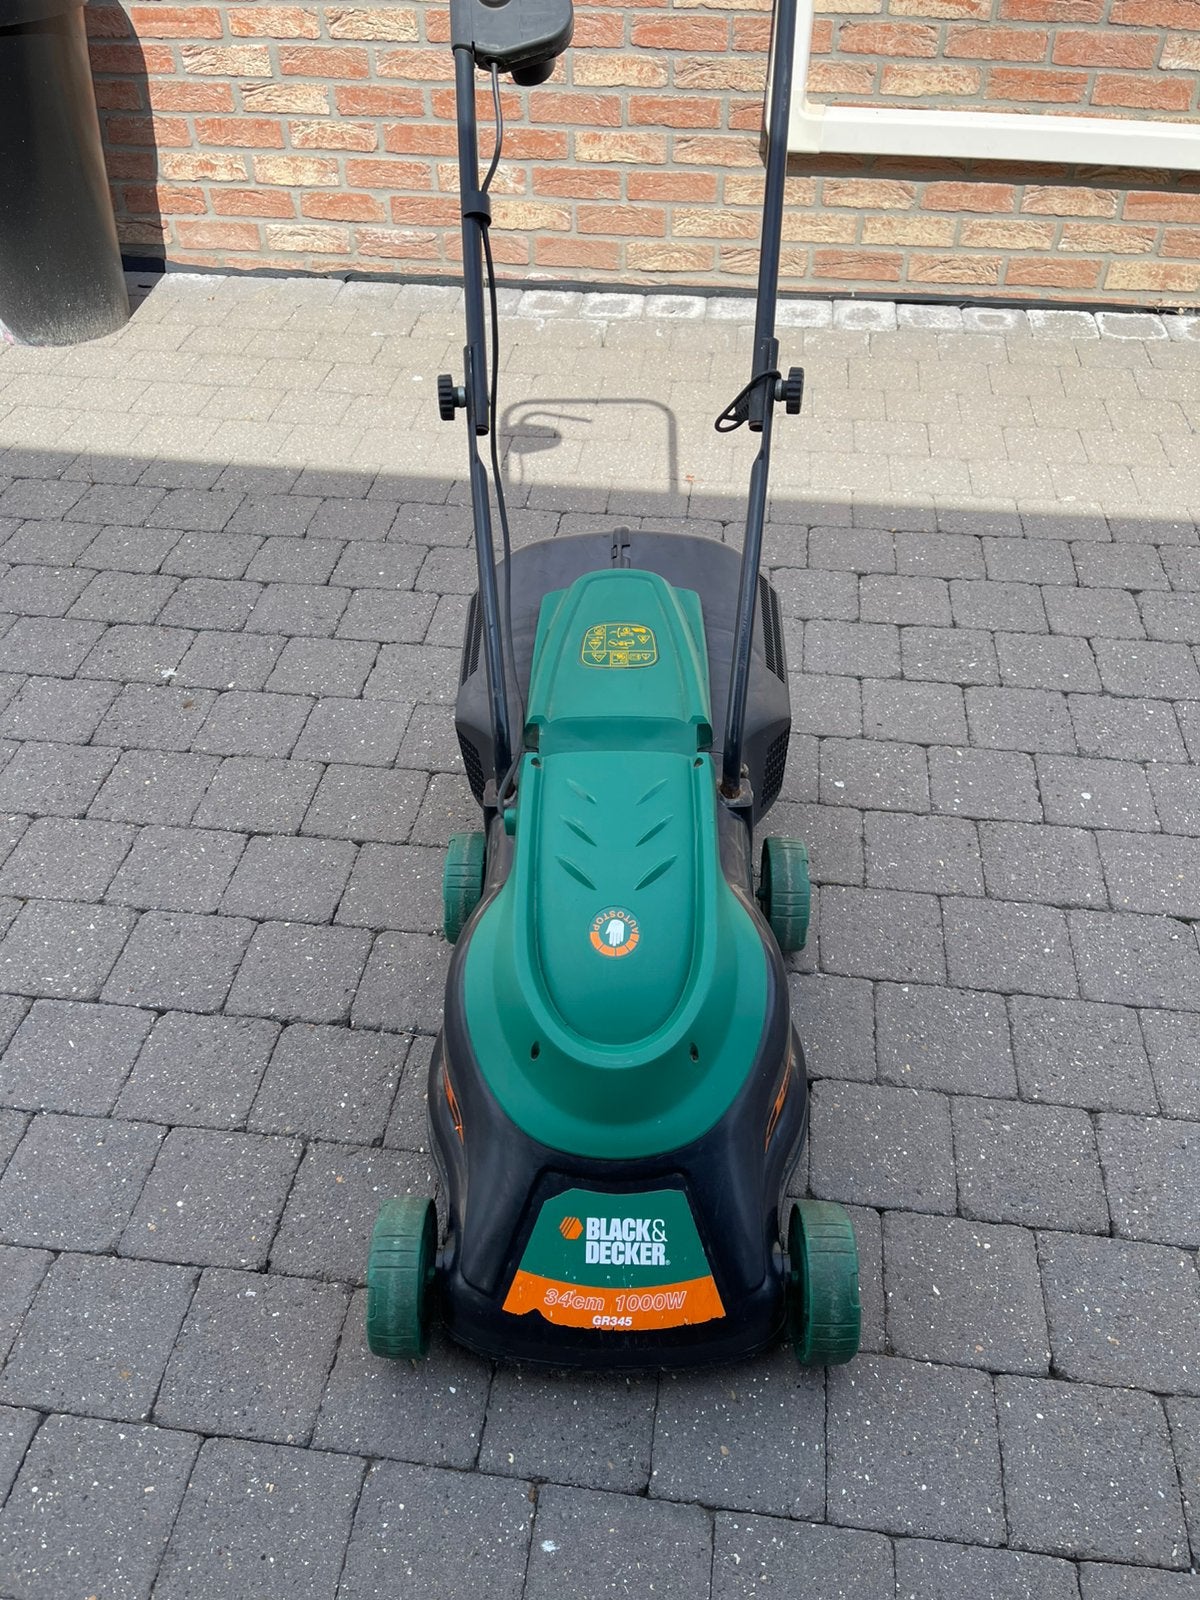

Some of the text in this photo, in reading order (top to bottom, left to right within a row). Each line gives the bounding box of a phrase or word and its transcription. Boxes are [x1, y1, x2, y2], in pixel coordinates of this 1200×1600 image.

[592, 910, 639, 933] AUTOSTOP
[543, 1289, 687, 1312] 34cm 1000W
[592, 1316, 632, 1327] GR345
